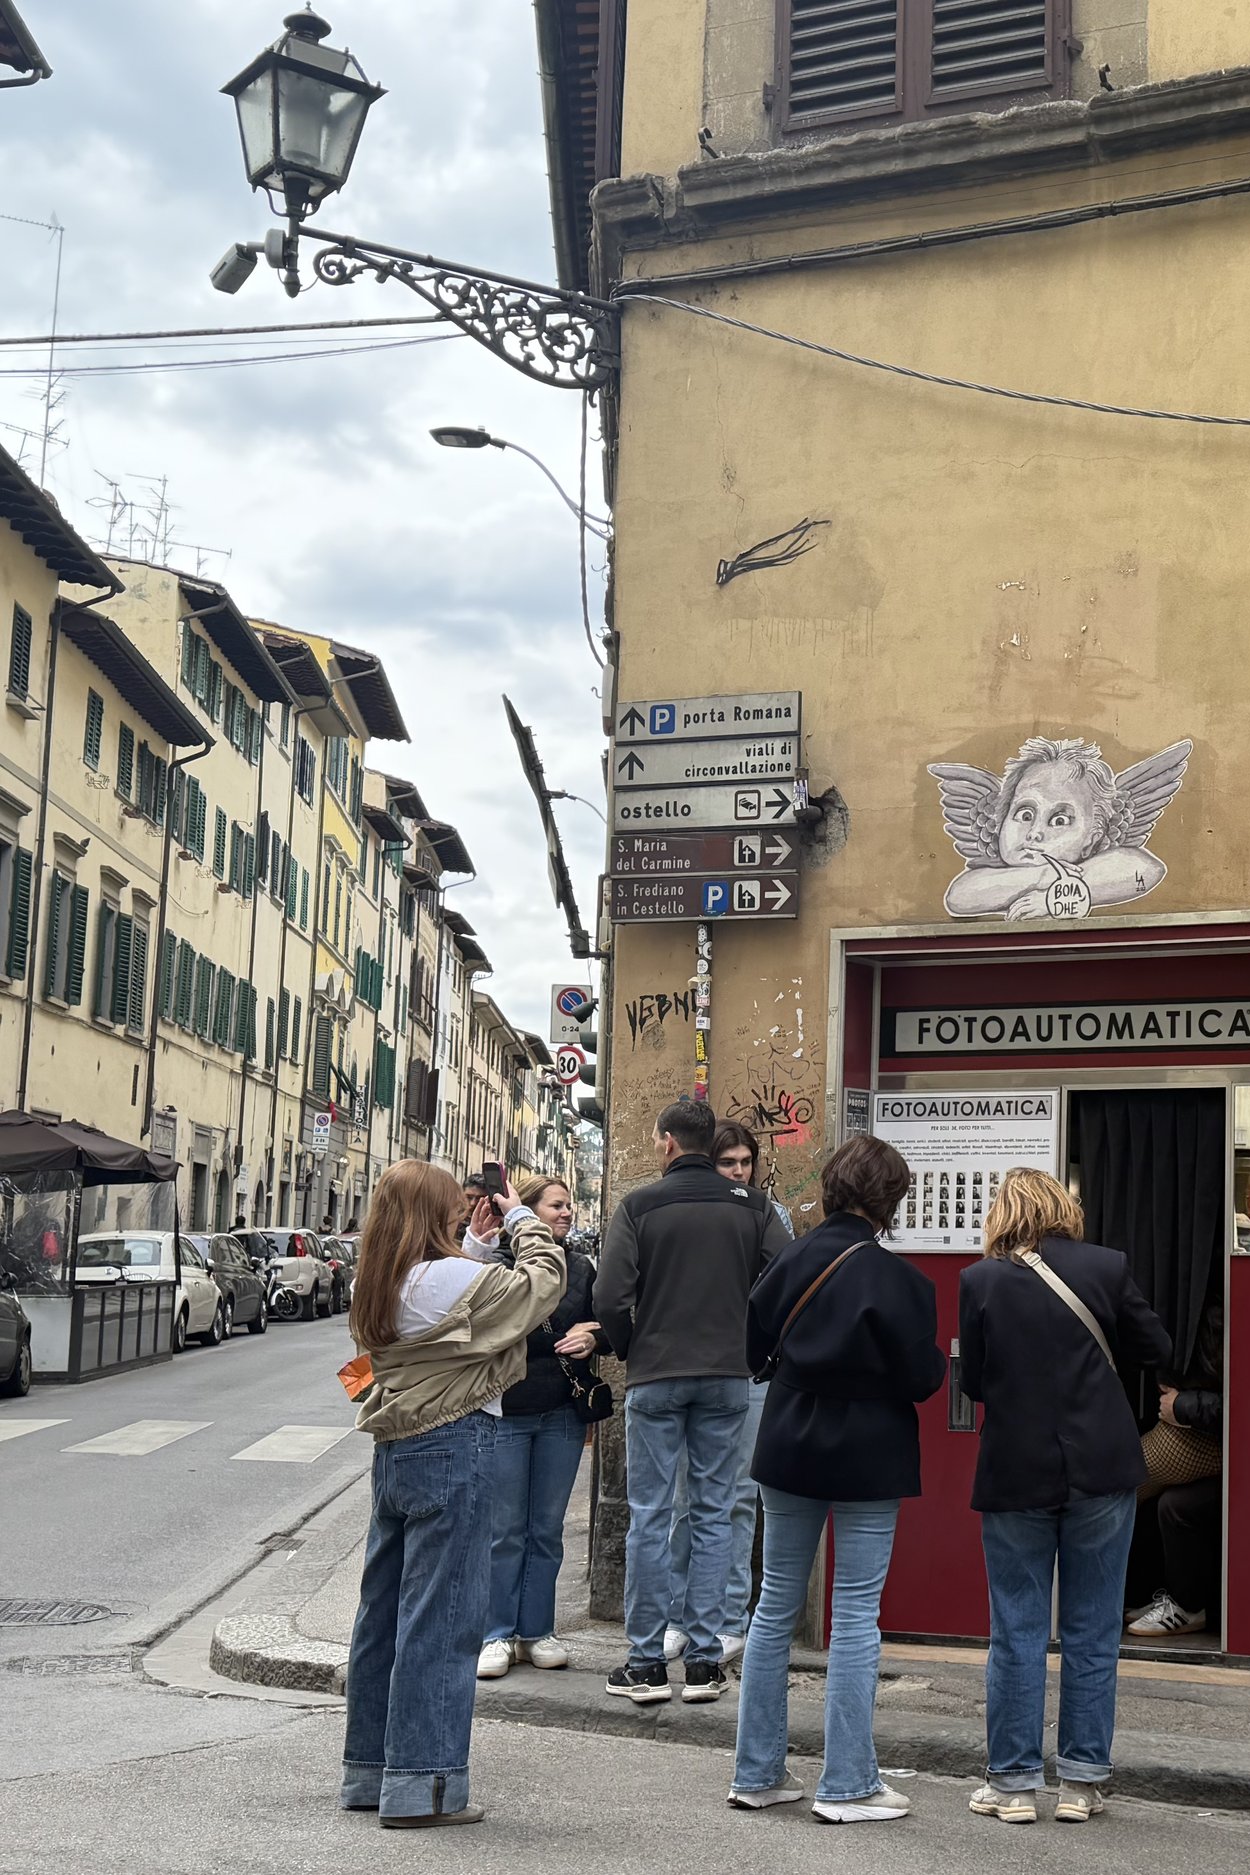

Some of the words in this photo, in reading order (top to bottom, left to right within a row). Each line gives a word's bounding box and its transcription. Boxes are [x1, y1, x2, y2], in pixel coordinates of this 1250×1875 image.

[683, 709, 725, 728] porta
[734, 706, 792, 721] Romana
[746, 743, 774, 757] viali
[780, 742, 792, 755] di
[685, 760, 791, 777] circonvallazione
[620, 801, 692, 820] ostello
[618, 840, 629, 853] S.
[634, 839, 667, 853] Maria
[616, 857, 635, 871] del
[641, 857, 691, 870] Carmine
[618, 885, 629, 897] S.
[633, 883, 684, 897] Frediano
[616, 903, 627, 915] in
[633, 901, 685, 914] Cestello
[559, 1056, 577, 1074] 30
[353, 1085, 364, 1144] TRATTORIA
[882, 1100, 1048, 1117] FOTOAUTOMATICA
